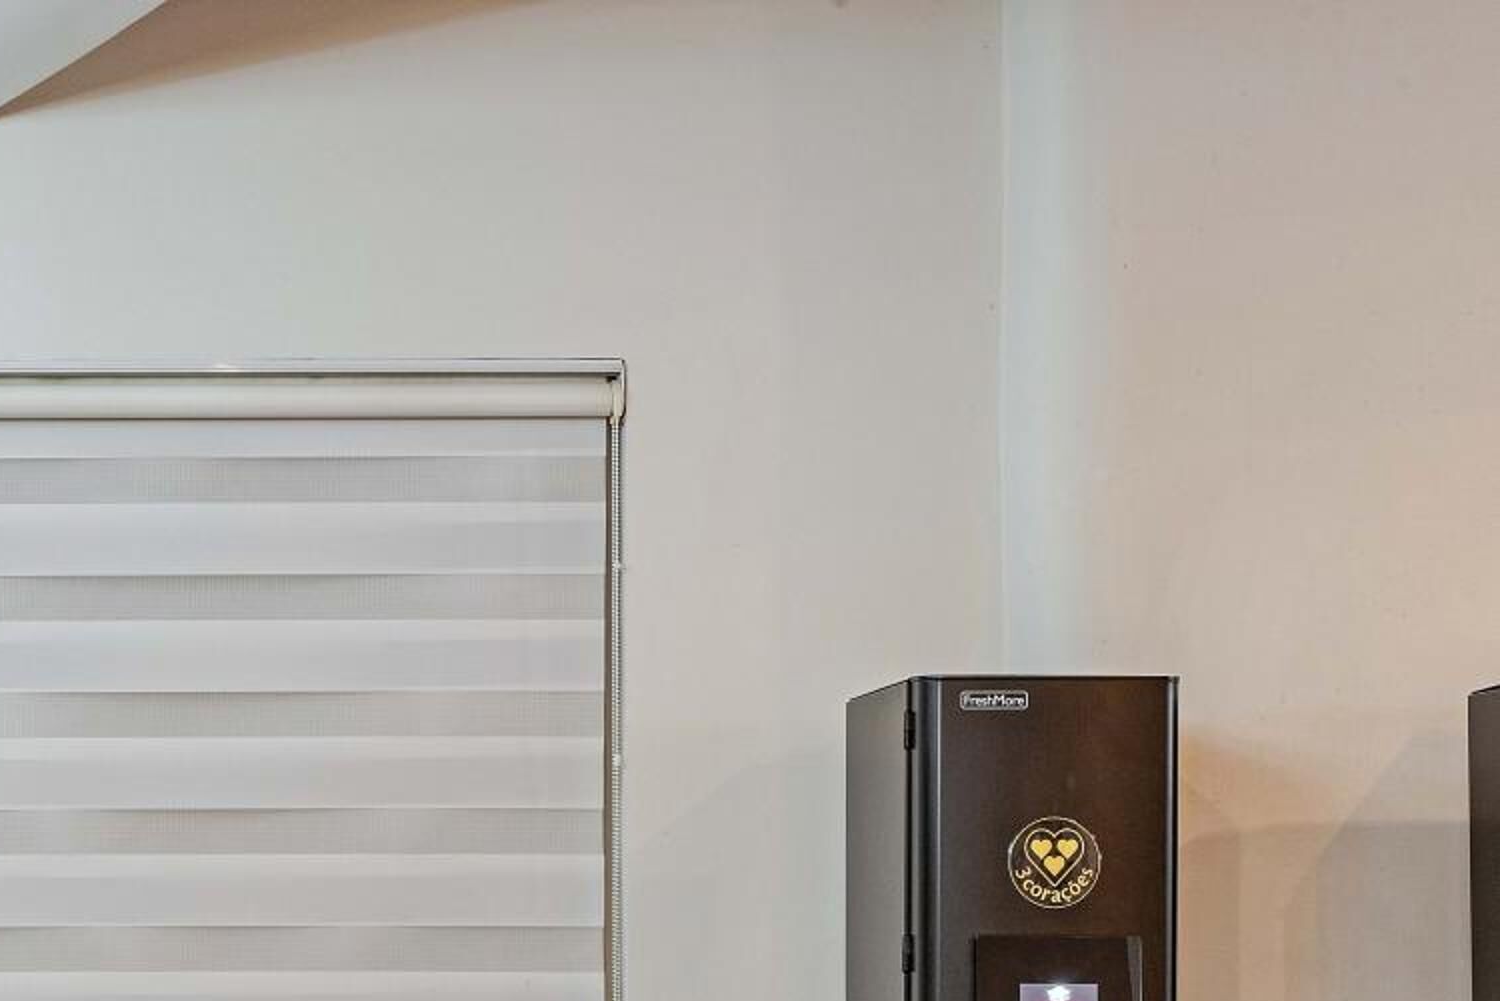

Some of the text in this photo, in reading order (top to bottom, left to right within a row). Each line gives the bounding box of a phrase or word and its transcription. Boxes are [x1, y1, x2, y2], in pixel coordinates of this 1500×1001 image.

[963, 693, 1025, 706] FreshMore
[1014, 865, 1094, 903] 3 corações
